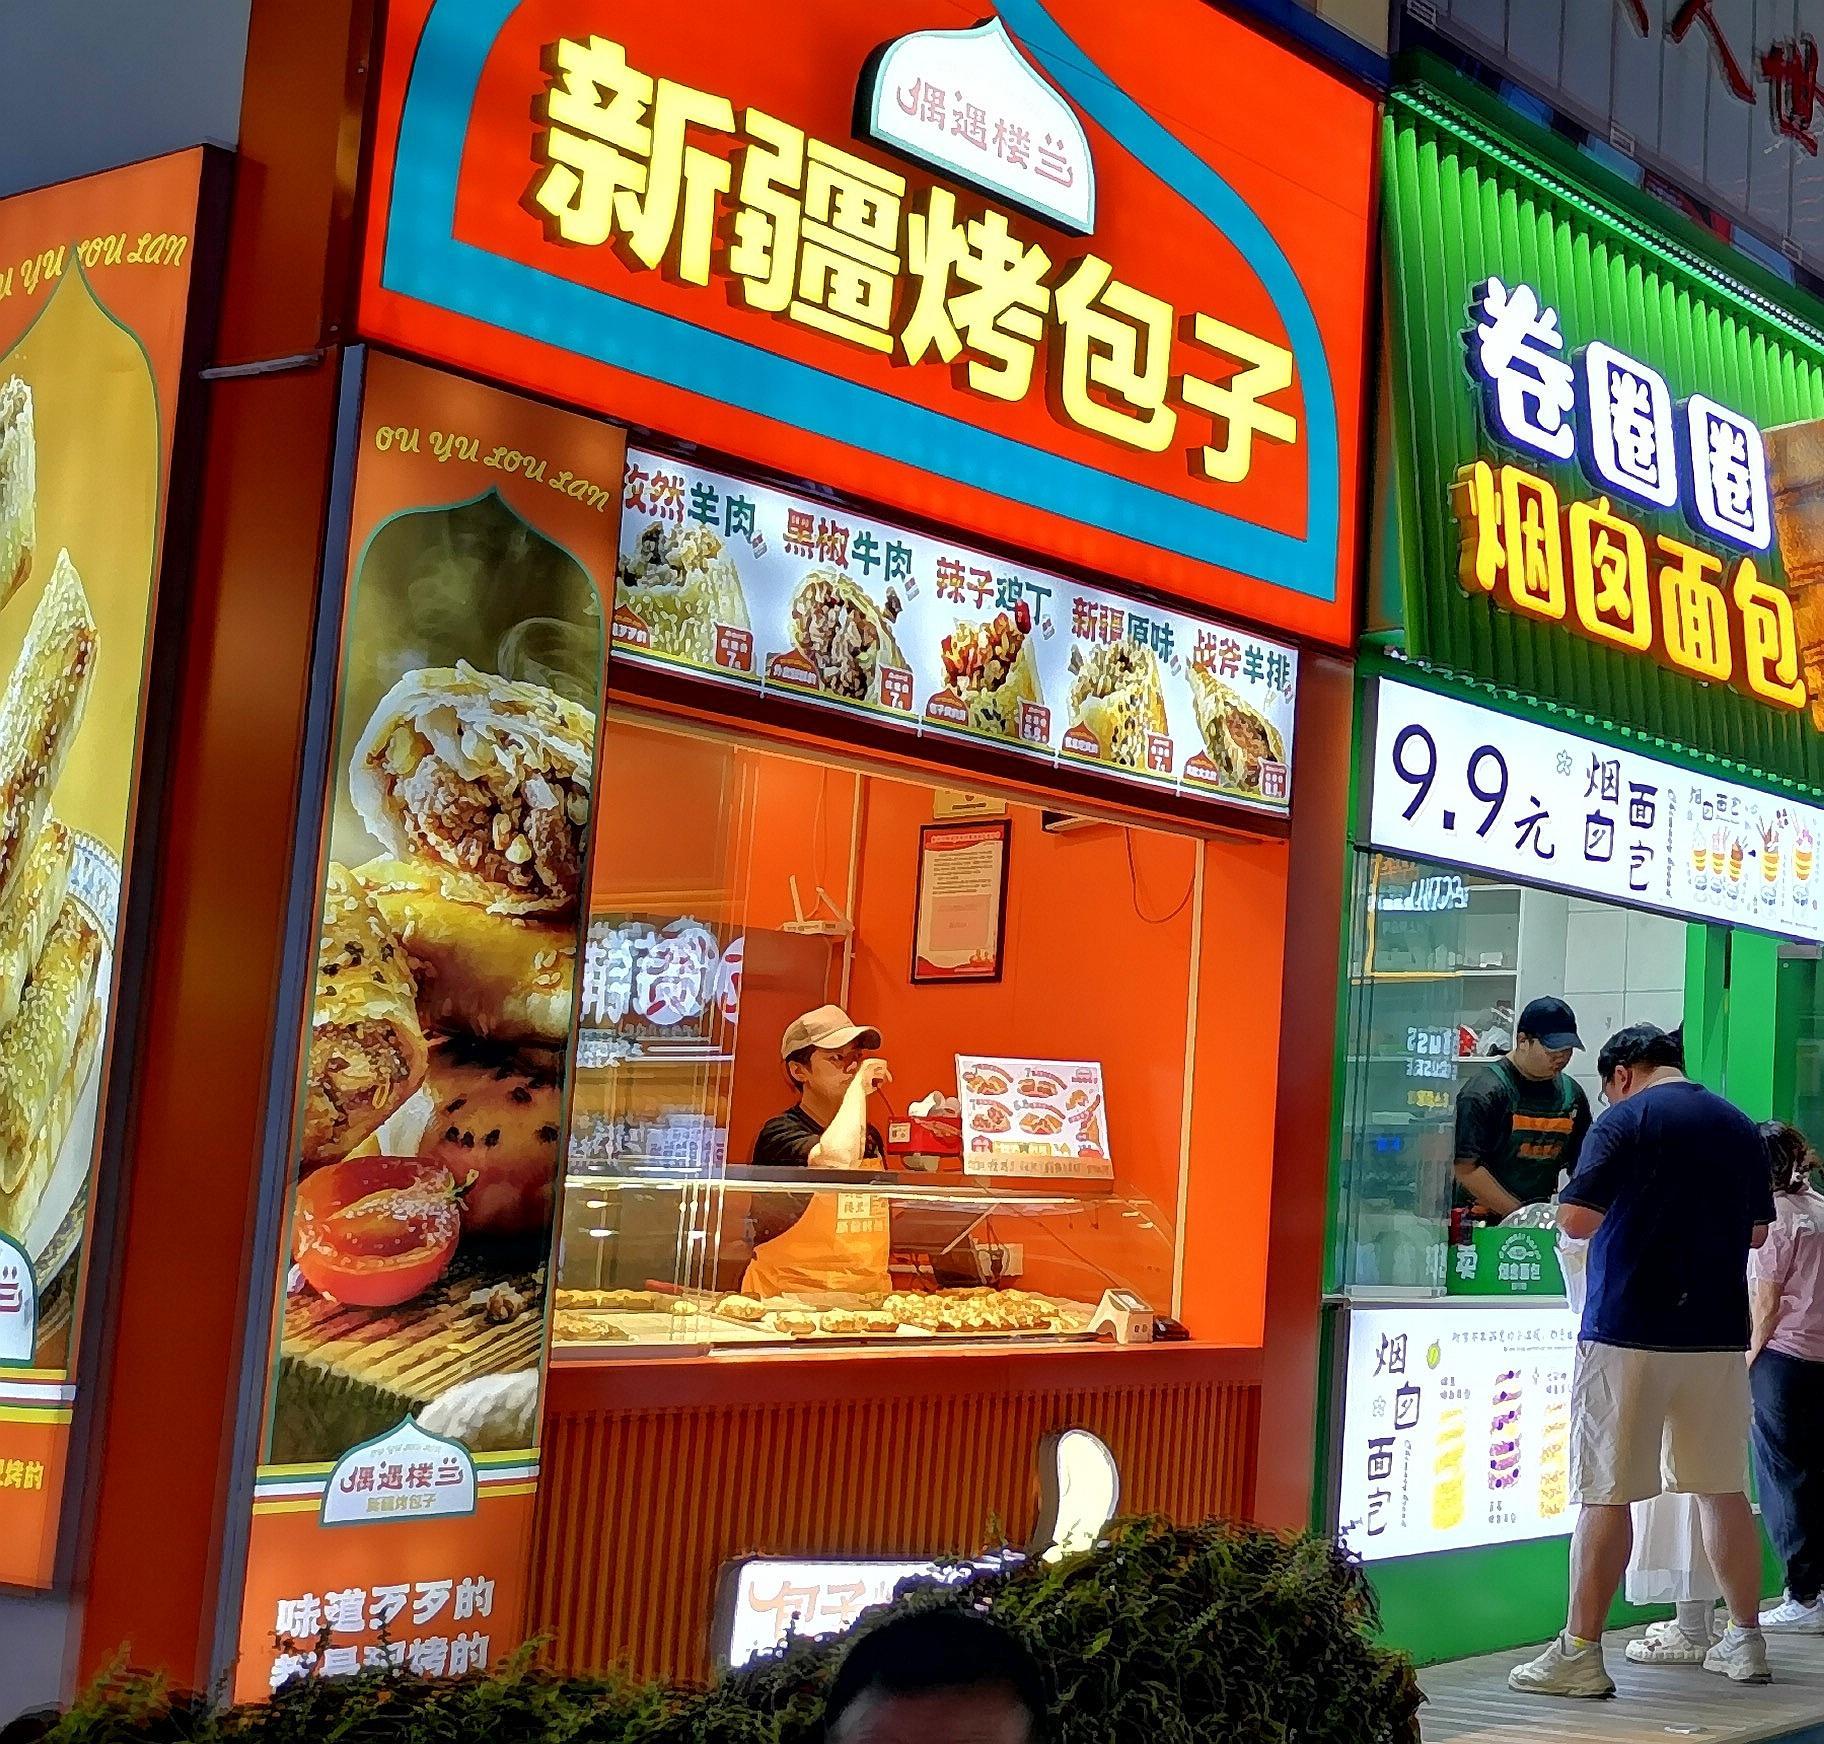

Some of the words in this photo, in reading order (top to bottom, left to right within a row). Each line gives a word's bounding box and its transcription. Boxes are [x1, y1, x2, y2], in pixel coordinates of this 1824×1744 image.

[896, 77, 1073, 188] 偶遇楼兰
[21, 245, 65, 295] YU
[127, 232, 188, 266] LAN
[536, 34, 1298, 484] 新疆烤包子
[1477, 275, 1772, 551] 卷圈圈
[375, 426, 420, 453] OU
[429, 431, 478, 463] YU
[483, 446, 547, 483] LOU
[549, 471, 609, 512] LAN
[783, 507, 913, 582] 黑椒牛肉
[936, 556, 1052, 626] 辣子鸡丁
[1468, 460, 1806, 710] 烟囱面包
[1072, 597, 1174, 663] 新疆原味
[1193, 629, 1291, 692] 战斧羊排
[340, 1457, 464, 1493] 偶遇楼兰
[276, 1576, 495, 1638] 味道歹歹的
